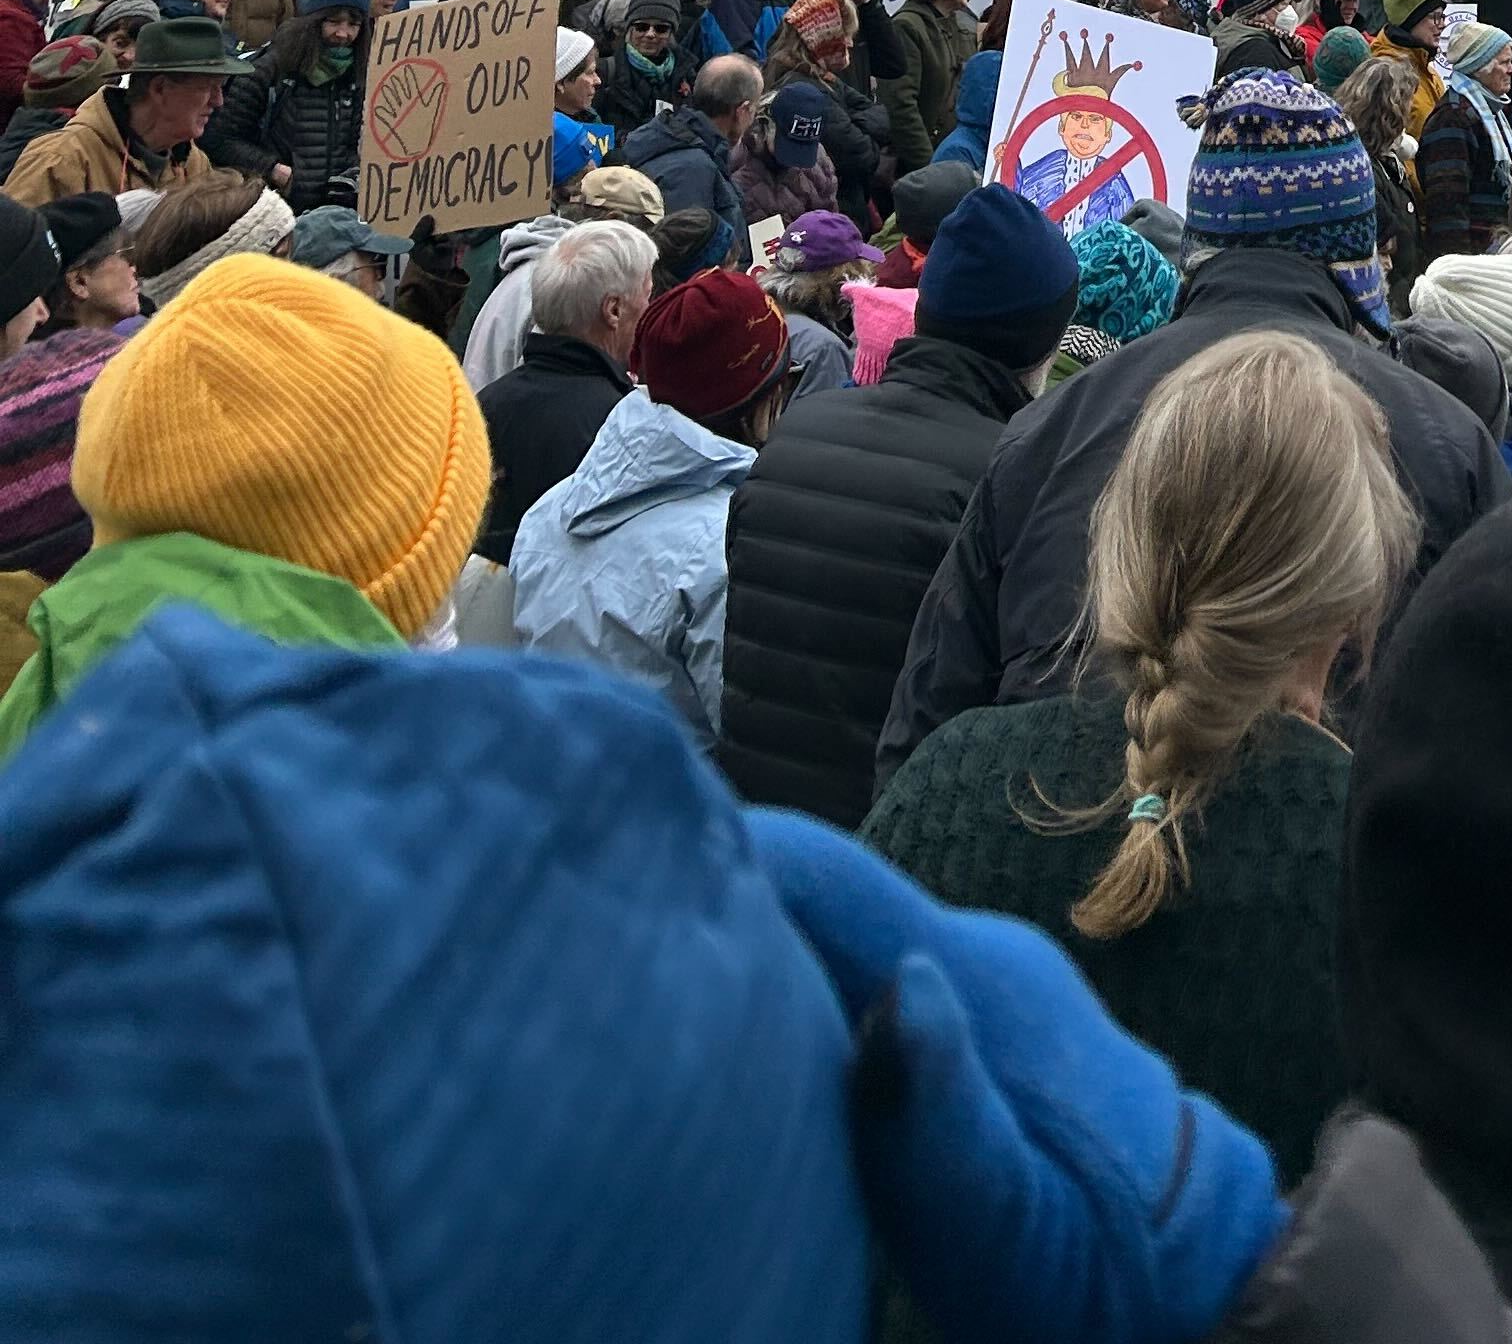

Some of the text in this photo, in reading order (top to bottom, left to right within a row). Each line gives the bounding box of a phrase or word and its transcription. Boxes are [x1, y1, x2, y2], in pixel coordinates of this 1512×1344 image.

[376, 1, 489, 65] HANDS
[466, 55, 531, 115] OUR
[364, 135, 553, 225] DEMOCRACY!
